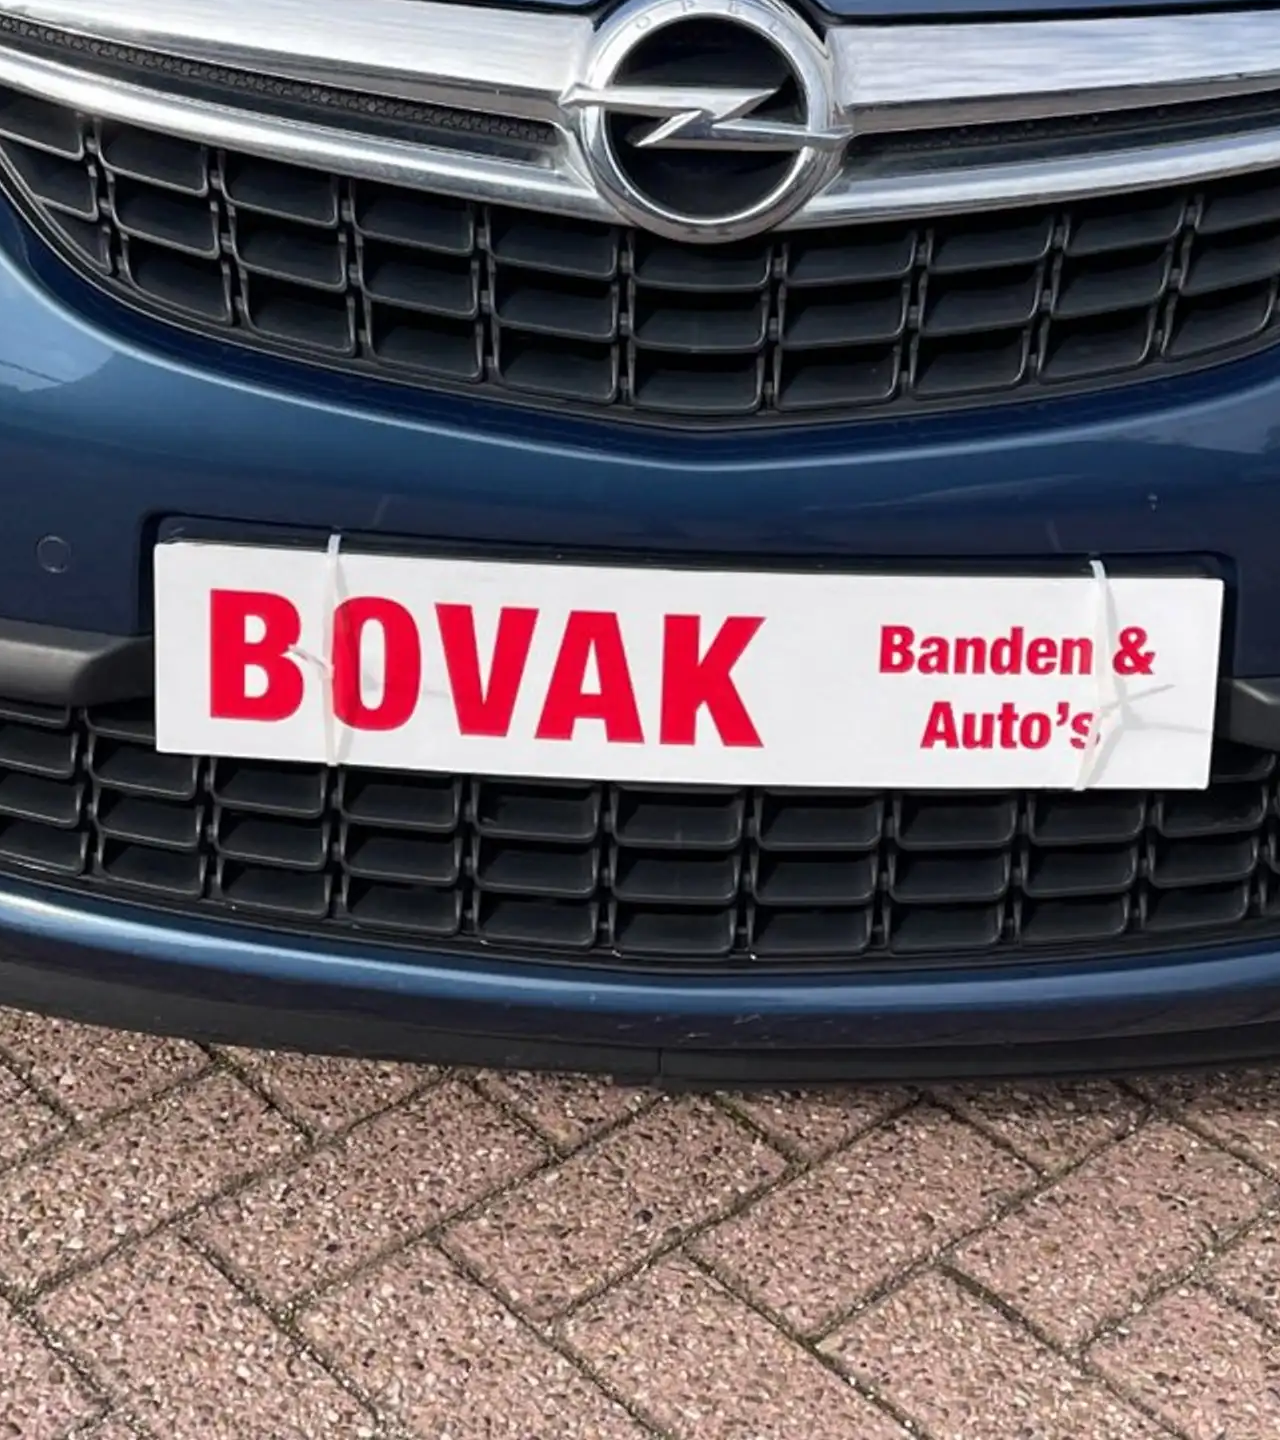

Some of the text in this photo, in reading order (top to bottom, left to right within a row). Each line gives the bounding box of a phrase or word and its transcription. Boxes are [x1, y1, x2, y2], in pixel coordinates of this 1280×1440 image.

[210, 588, 767, 748] BOVAK
[879, 625, 1155, 675] Banden &
[920, 701, 1101, 749] Auto's
